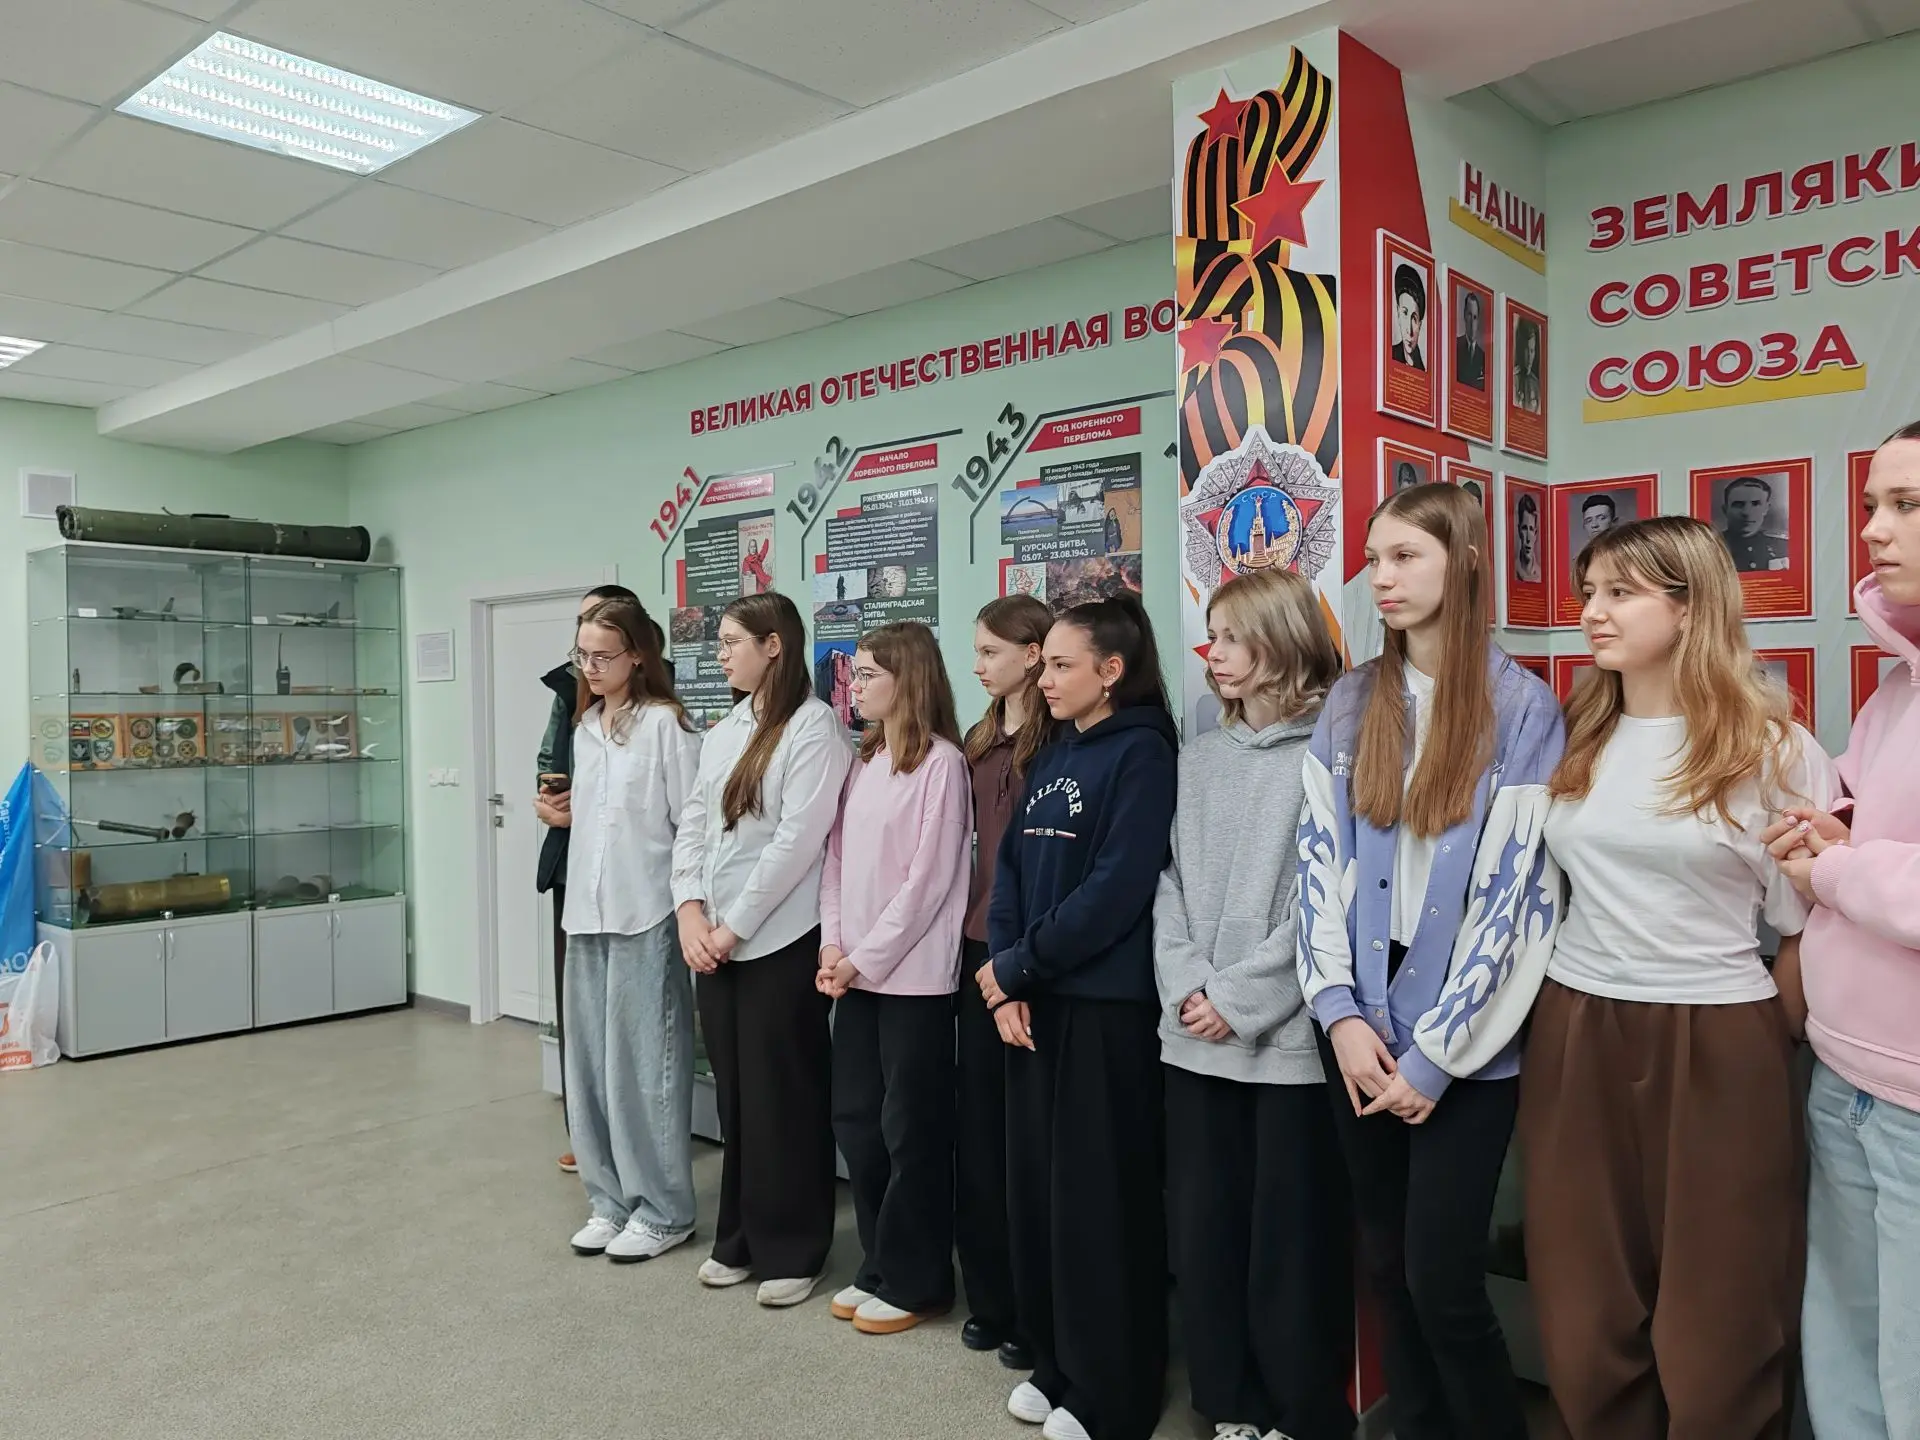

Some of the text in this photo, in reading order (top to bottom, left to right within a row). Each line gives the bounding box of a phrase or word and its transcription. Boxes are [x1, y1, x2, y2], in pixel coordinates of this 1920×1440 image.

[1460, 160, 1546, 256] НАШИ
[1587, 324, 1864, 402] СОЮЗА
[690, 381, 813, 436] ВЕЛИКАЯ
[819, 311, 1110, 407] ОТЕЧЕСТВЕННАЯ
[1052, 414, 1124, 434] ГОД КОРЕННОГО
[1063, 428, 1112, 444] ПЕРЕЛОМА
[879, 452, 909, 463] НАЧАЛО
[951, 401, 1027, 505] 1943
[854, 458, 936, 478] КОРЕННОГО ПЕРЕЛОМА
[786, 435, 850, 526] 1942
[862, 488, 922, 503] РЖЕВСКАЯ БИТВА
[1241, 490, 1277, 503] СССР
[650, 466, 702, 543] 1941
[1021, 539, 1087, 553] КУРСКАЯ БИТВА
[1050, 549, 1089, 560] 23.08.1943
[863, 598, 925, 611] СТАЛИНГРАДСКАЯ
[863, 610, 886, 619] БИТВА
[698, 660, 721, 669] ОБОРО
